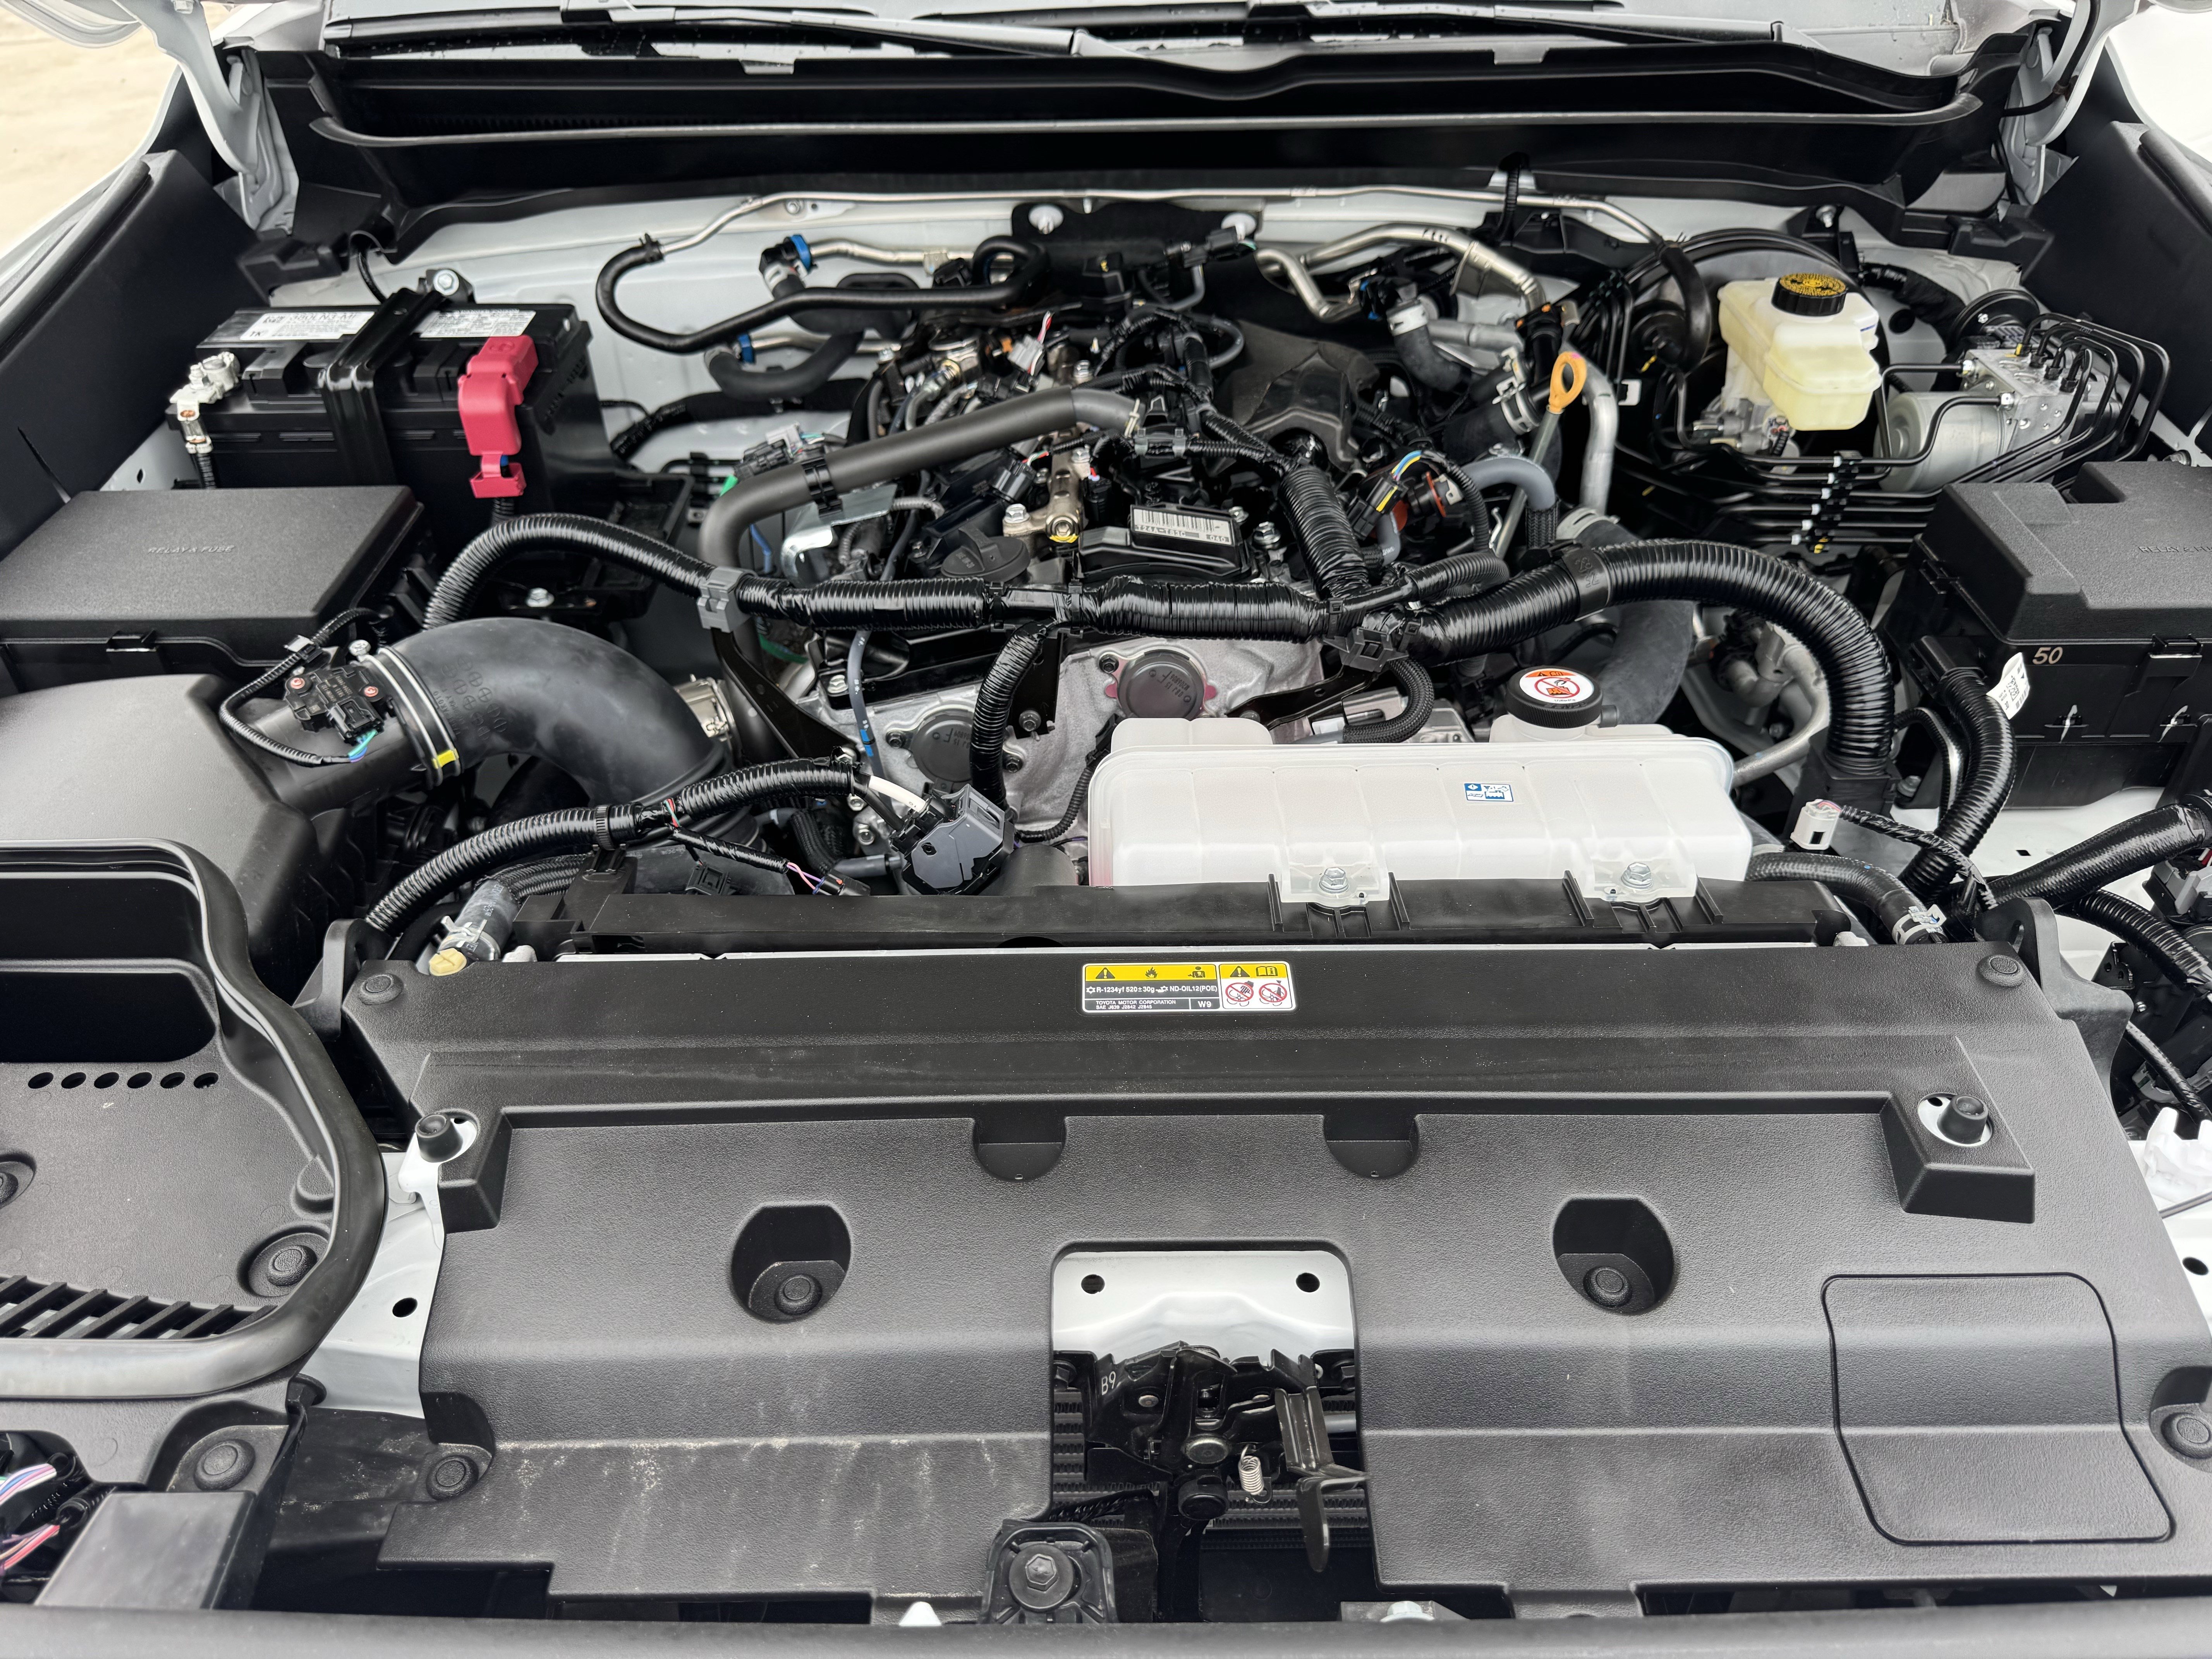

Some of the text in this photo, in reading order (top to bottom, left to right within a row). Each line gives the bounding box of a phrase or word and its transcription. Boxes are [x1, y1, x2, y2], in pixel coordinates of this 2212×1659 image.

[2032, 646, 2063, 665] 50
[1096, 986, 1125, 994] R-1234yf
[1101, 1371, 1116, 1395] B9
